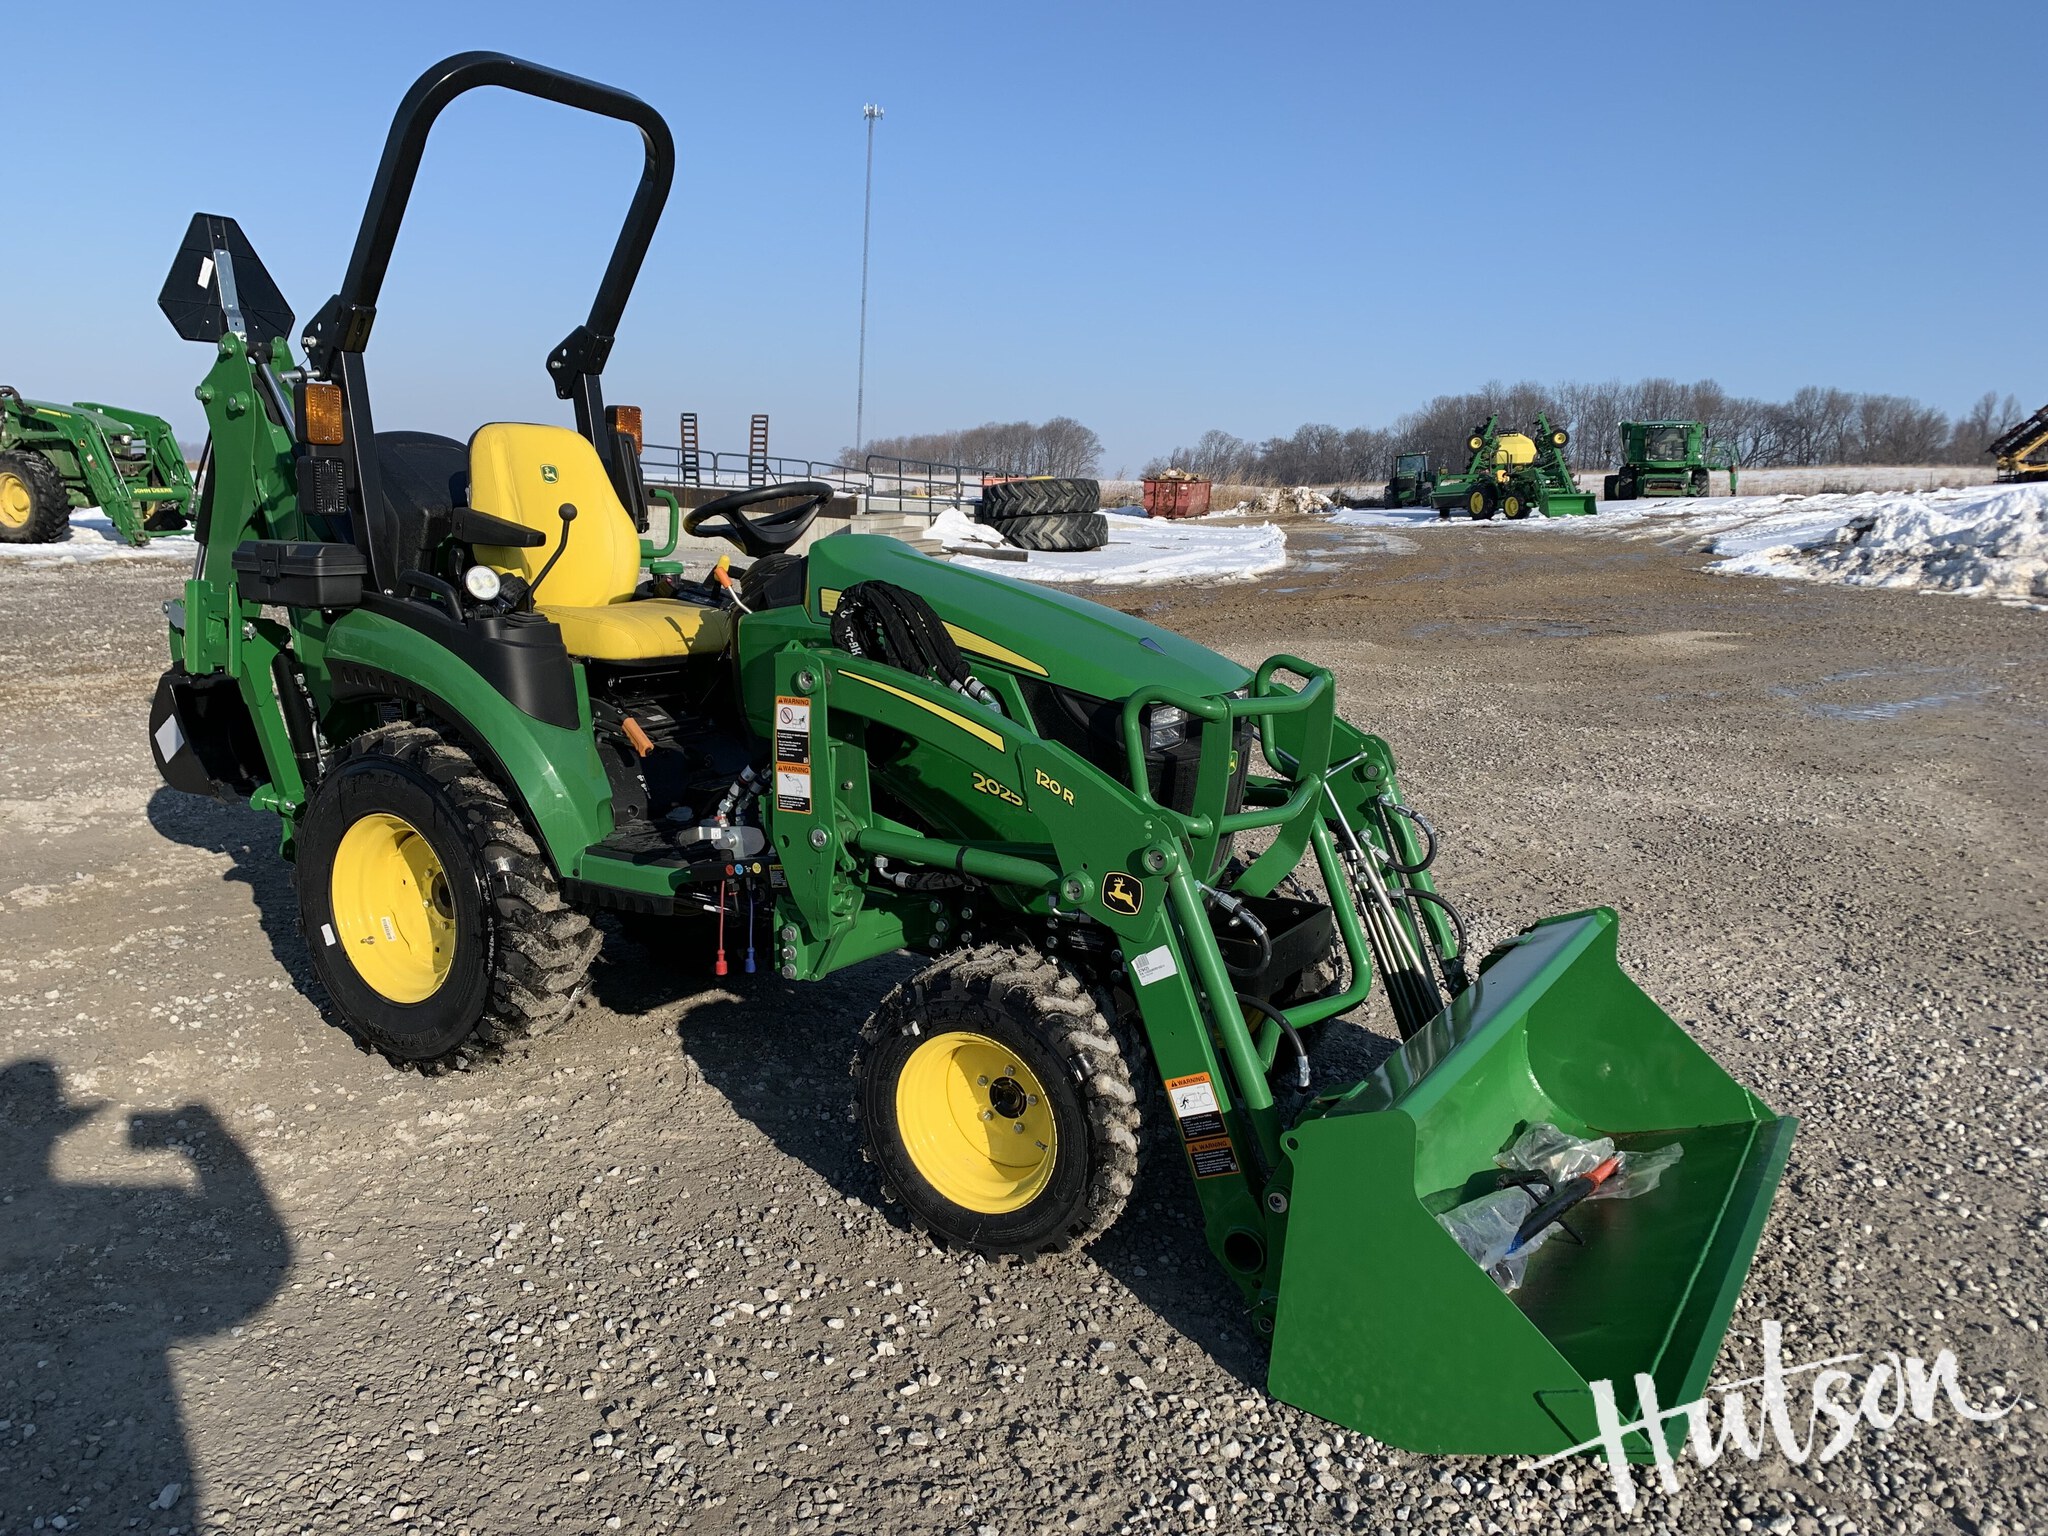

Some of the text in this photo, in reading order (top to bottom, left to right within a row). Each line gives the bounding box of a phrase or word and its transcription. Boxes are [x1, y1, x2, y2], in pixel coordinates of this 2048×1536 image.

[783, 697, 809, 706] WARNING
[783, 765, 809, 774] WARNING
[972, 772, 1031, 811] 2025
[1035, 768, 1075, 807] 120 R
[1178, 1075, 1205, 1086] WARNING
[1199, 1141, 1228, 1150] WARNING
